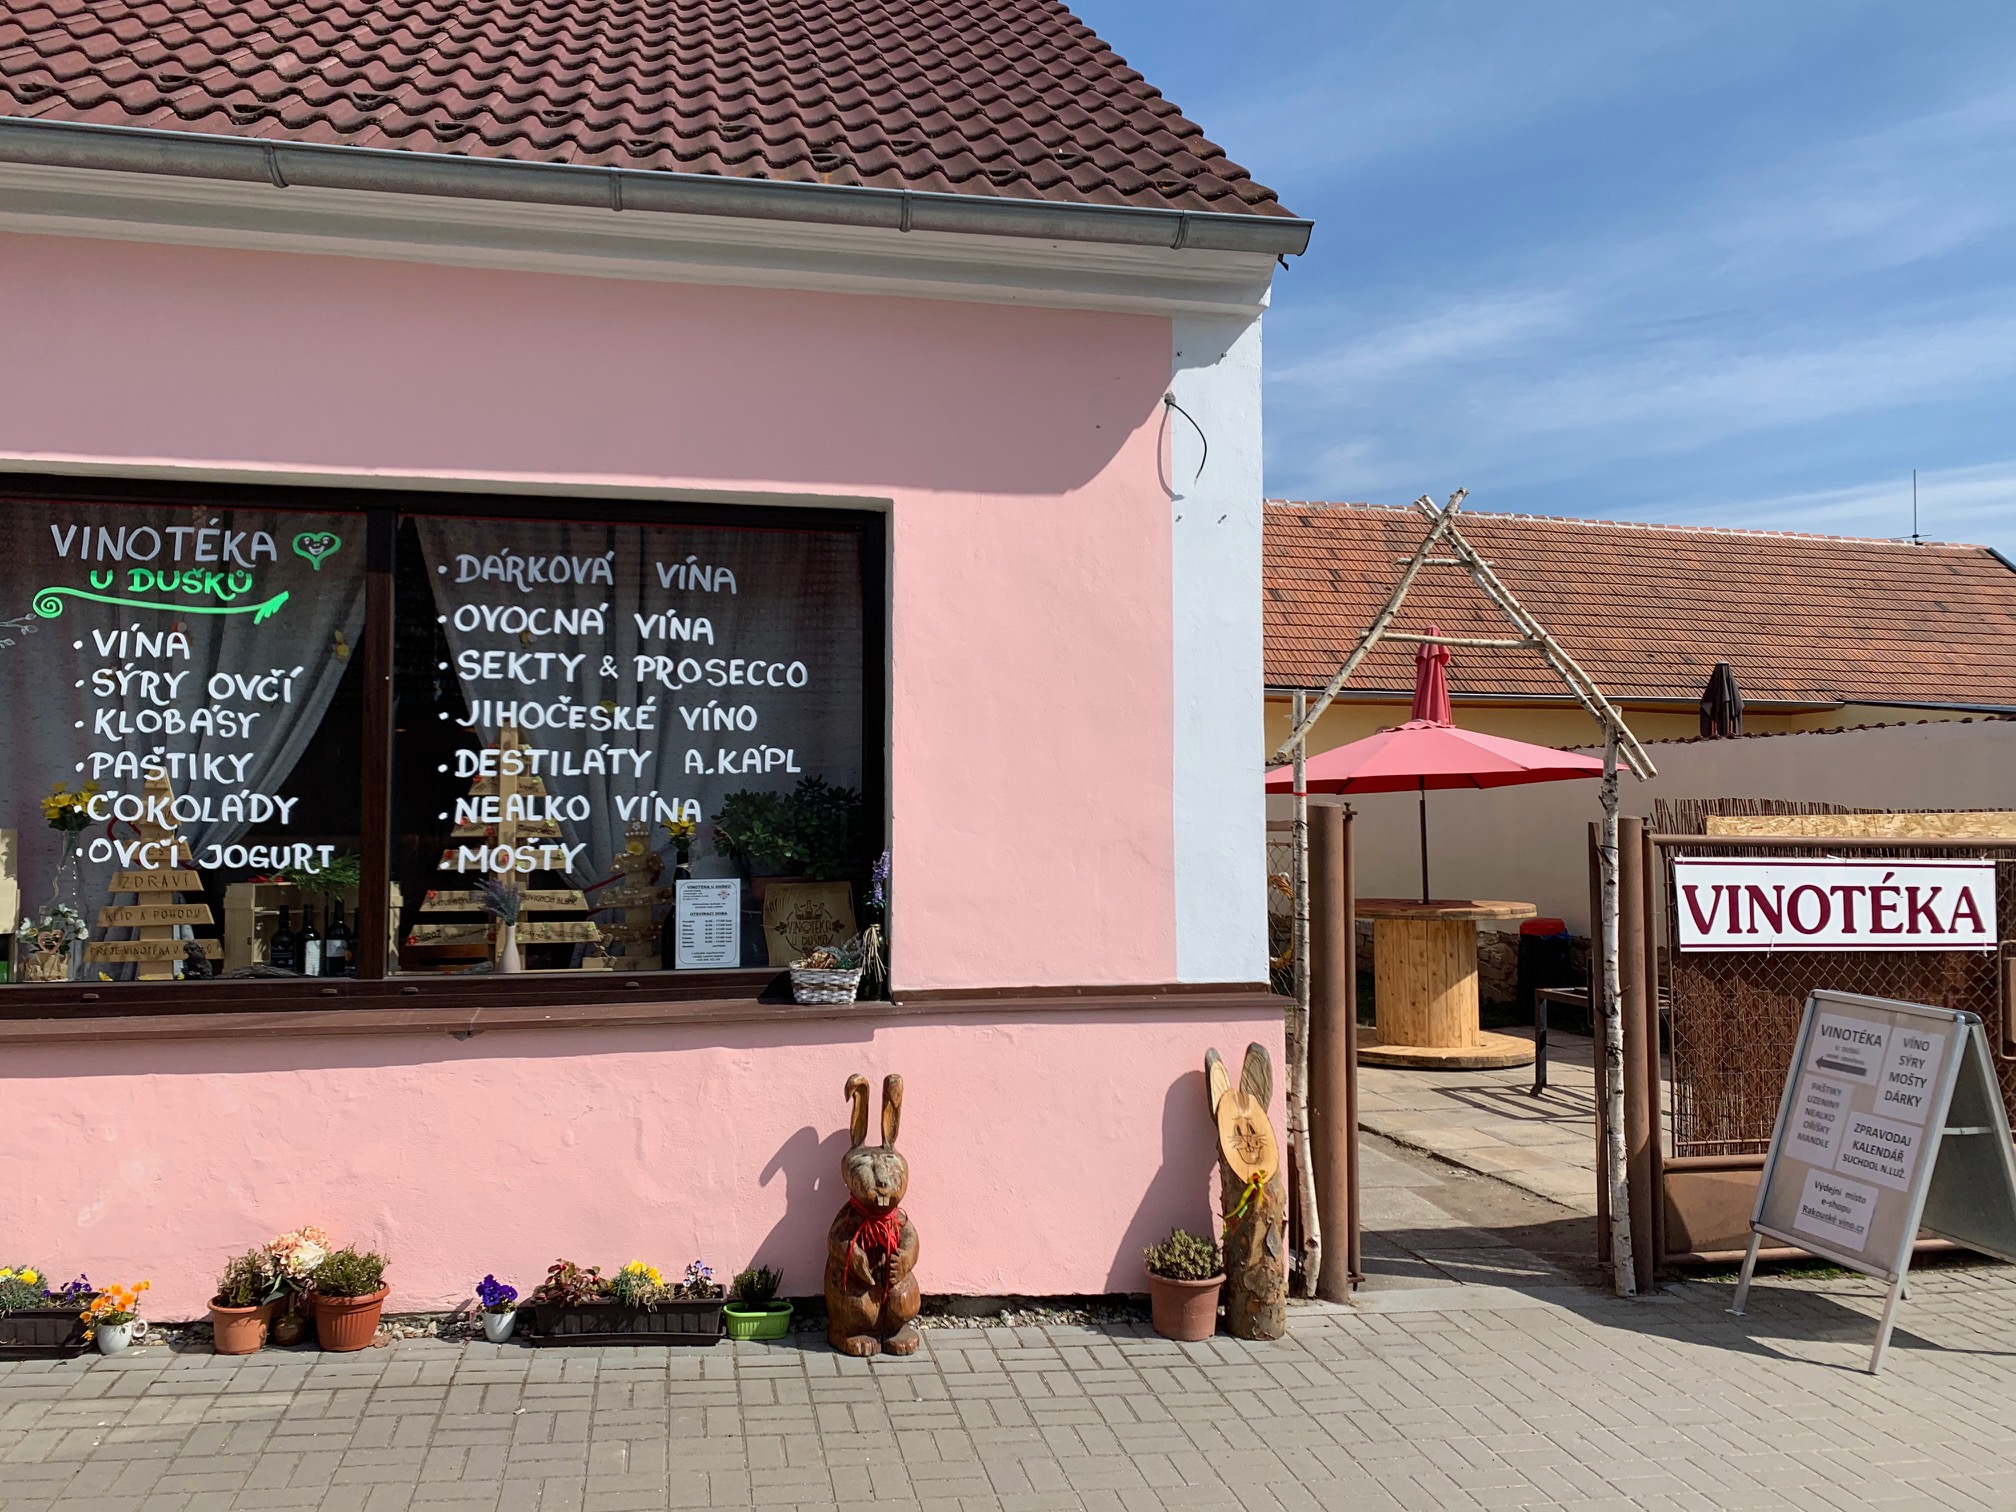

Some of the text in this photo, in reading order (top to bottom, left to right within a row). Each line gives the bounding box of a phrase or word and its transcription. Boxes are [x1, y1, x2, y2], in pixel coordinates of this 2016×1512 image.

[50, 518, 278, 568] VINOTÉKA
[89, 567, 253, 601] U DUŠKŮ
[454, 548, 738, 595] DÁRKOVÁ VÍNA
[453, 602, 715, 646] OVOCNÁ VÍNA
[91, 623, 190, 660] VÍNA
[91, 663, 304, 706] SÝRY OVČÍ
[457, 649, 809, 691] SEKTY & PROSECCO
[93, 704, 261, 742] KLOBÁSY
[455, 695, 759, 732] JIHOČESKÉ VÍNO
[86, 746, 254, 784] PAŠTIKY
[453, 744, 653, 778] DESTILÁTY
[87, 790, 300, 831] ČOKOLÁDY
[453, 790, 703, 824] NEALKO VÍNA
[88, 835, 335, 874] OVČÍ JOGURT
[456, 837, 587, 875] MOŠTY
[1682, 872, 1988, 935] VINOTÉKA
[1821, 1024, 1882, 1047] VINOTÉKA
[1903, 1036, 1930, 1051] VÍNO
[1898, 1054, 1926, 1069] SÝRY
[1888, 1071, 1928, 1088] MOŠTY
[1804, 1107, 1836, 1122] NEALKO
[1884, 1089, 1922, 1107] DÁRKY
[1797, 1132, 1830, 1149] MANDLE
[1852, 1140, 1905, 1163] KALENDÁŘ
[1853, 1123, 1912, 1147] ZPRAVODAJ
[1842, 1153, 1879, 1172] SUCHDOL
[1821, 1198, 1852, 1214] e-shopu
